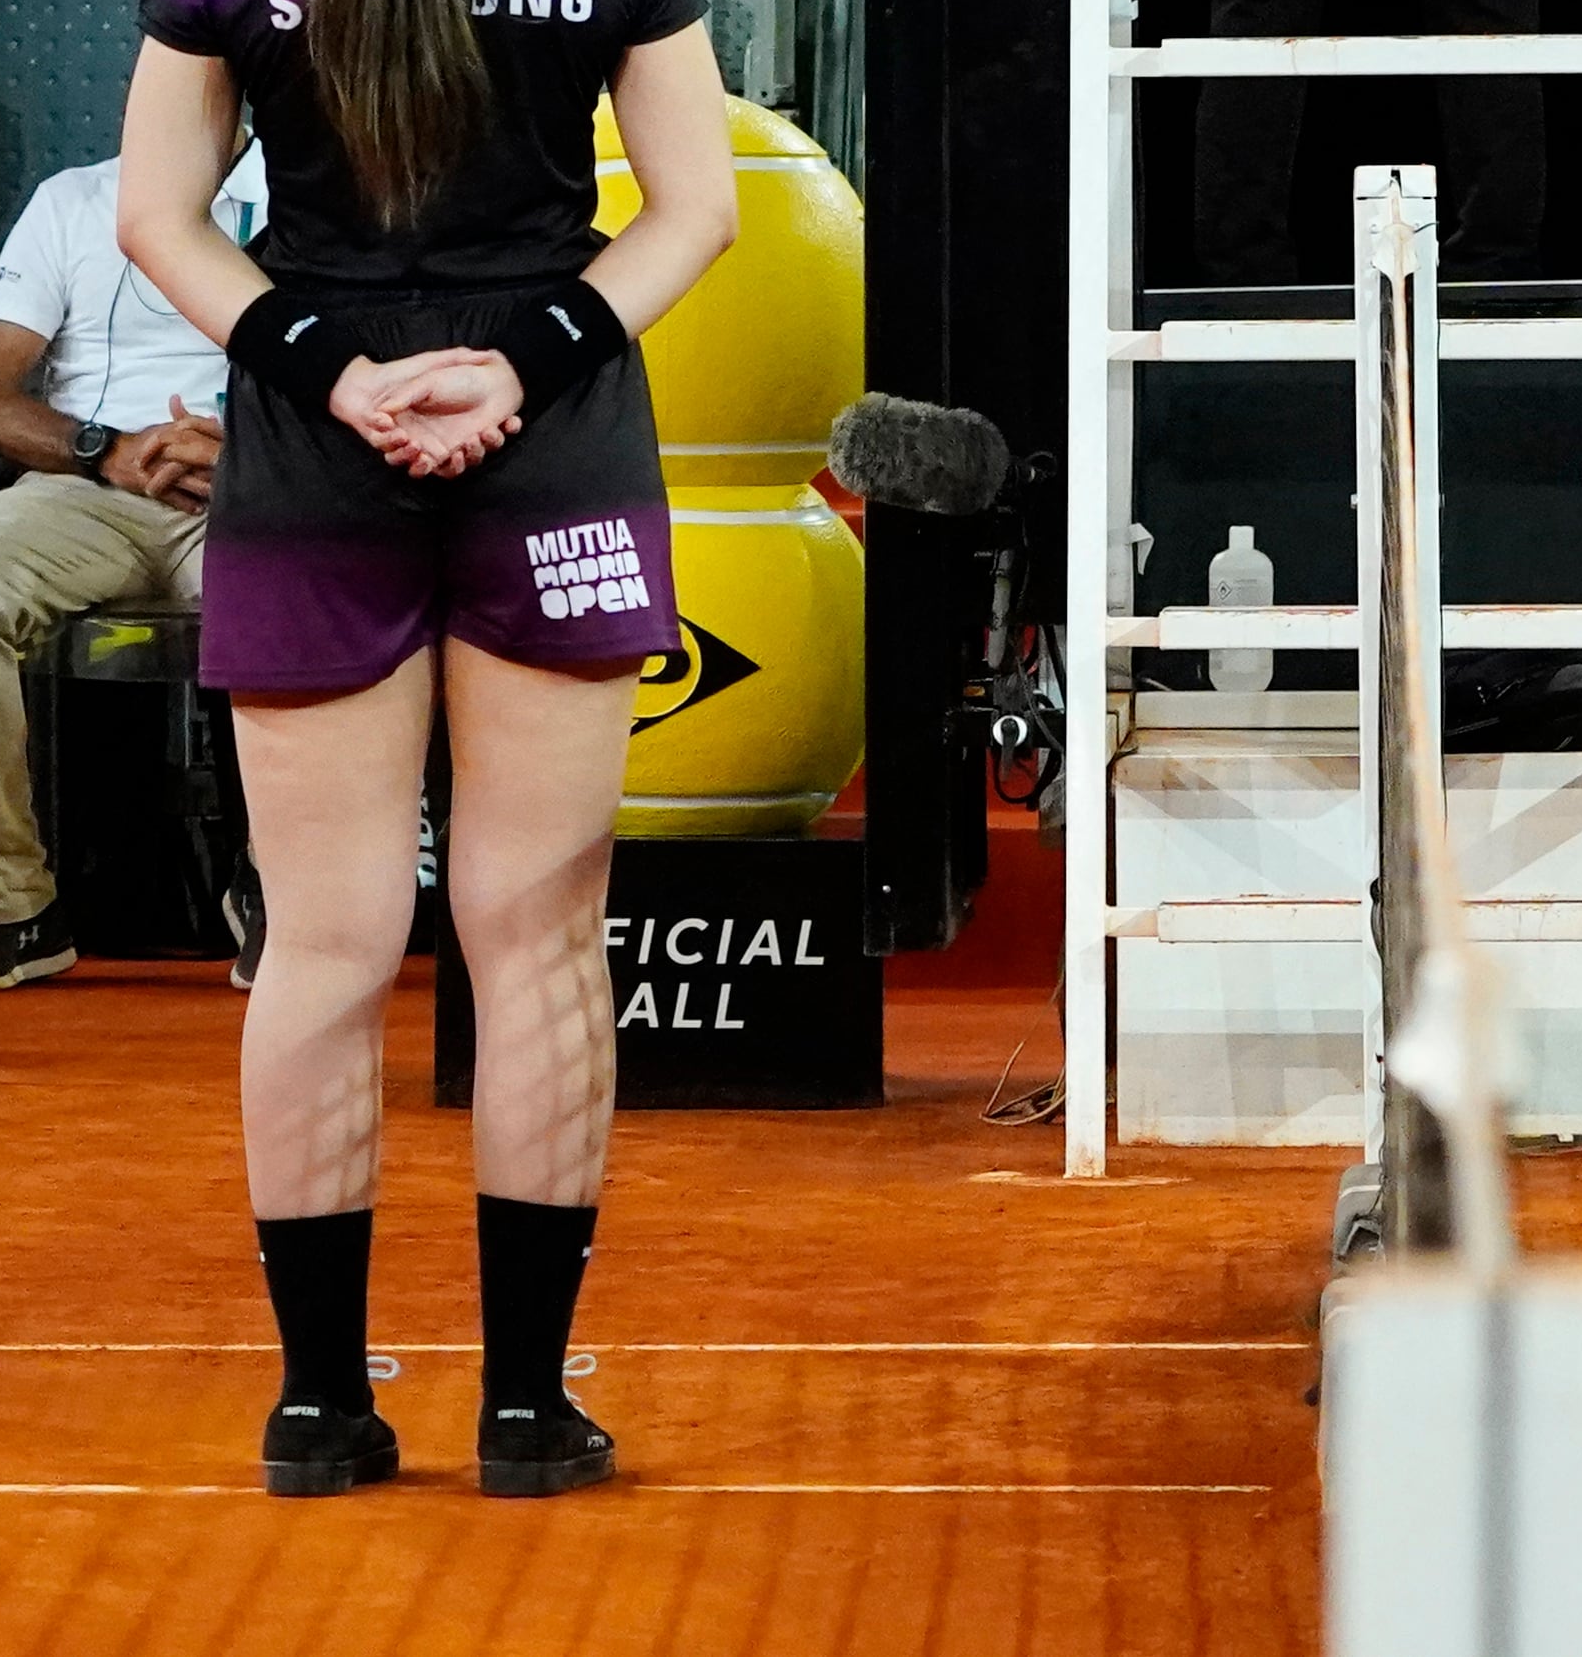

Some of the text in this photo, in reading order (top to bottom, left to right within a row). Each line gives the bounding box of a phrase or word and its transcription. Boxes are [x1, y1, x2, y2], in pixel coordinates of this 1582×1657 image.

[525, 518, 636, 567] MUTUA
[533, 549, 641, 590] MADRID
[539, 575, 650, 619] OPEN
[604, 918, 824, 965] FICIAL
[617, 982, 745, 1029] ALL
